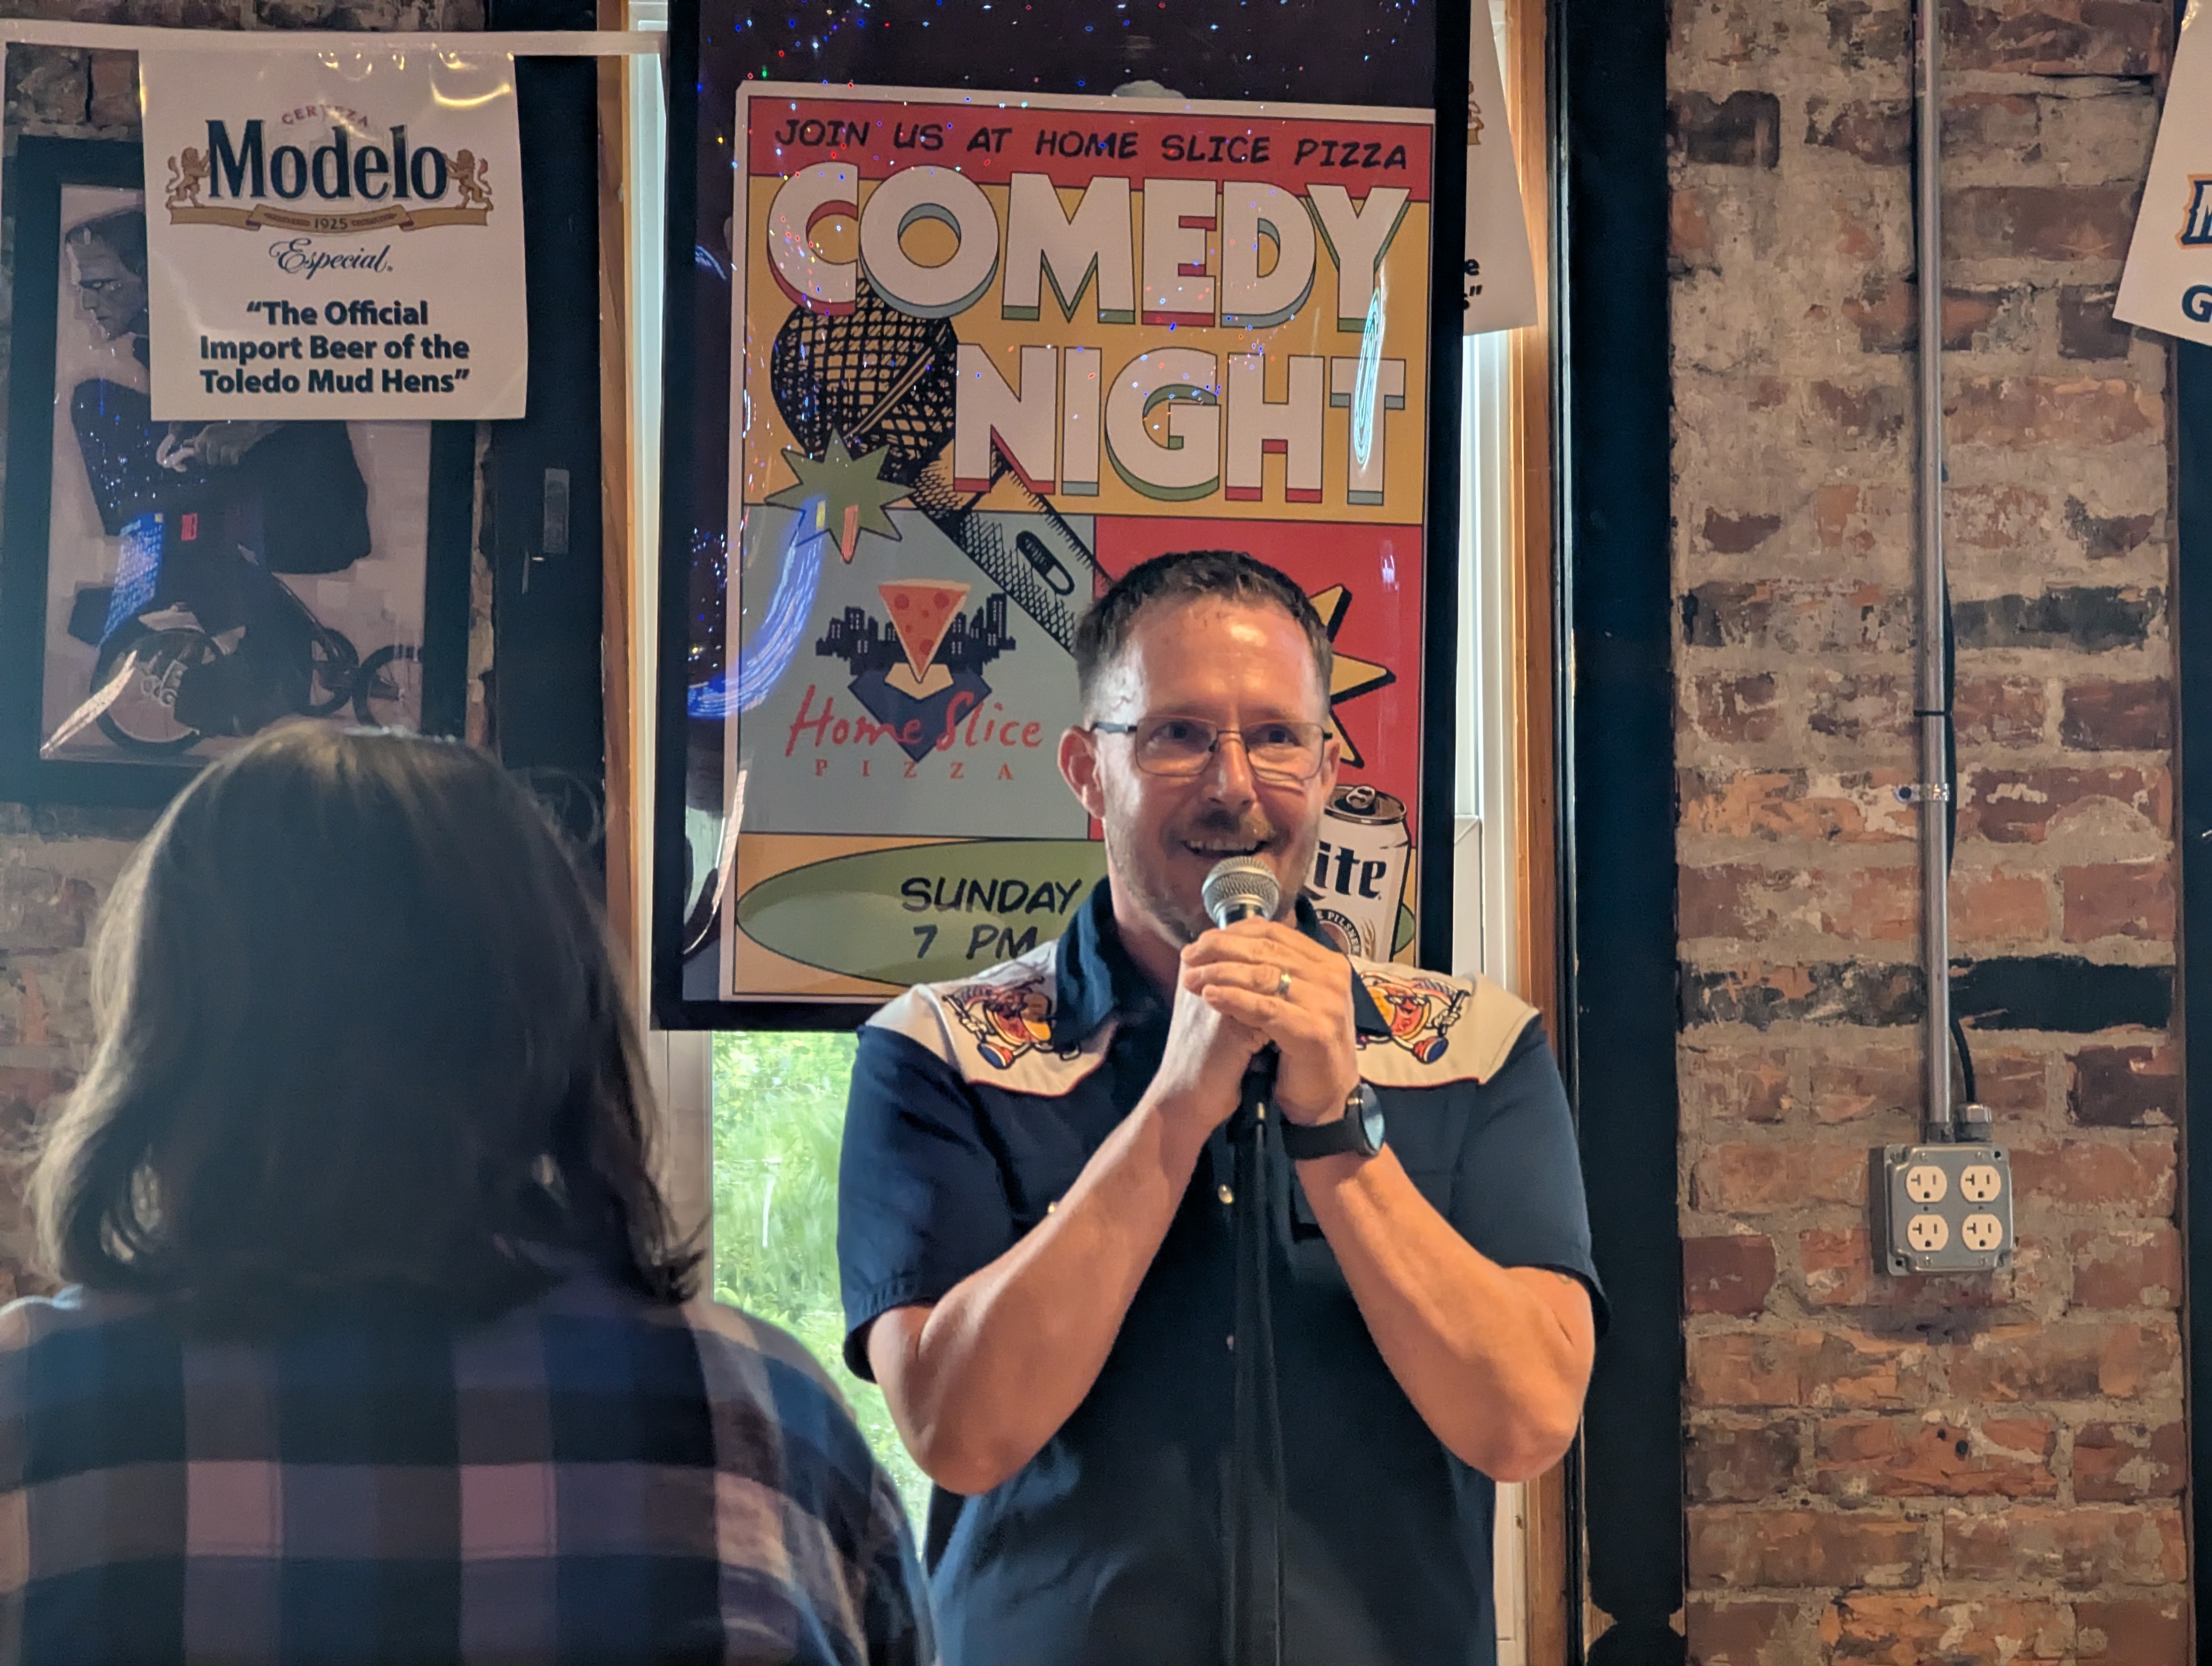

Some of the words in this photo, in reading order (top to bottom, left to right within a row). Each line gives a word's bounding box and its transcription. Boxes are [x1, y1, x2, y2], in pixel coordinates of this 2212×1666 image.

[205, 119, 449, 200] Modelo
[775, 119, 870, 147] JOIN
[893, 122, 944, 151] US
[967, 126, 1012, 153] AT
[1035, 129, 1139, 159] HOME
[1161, 134, 1270, 163] SLICE
[1294, 138, 1407, 170] PIZZA
[314, 218, 348, 230] 1925
[767, 161, 1411, 332] COMEDY
[246, 300, 318, 325] “The
[324, 300, 428, 325] Official
[200, 335, 303, 366] Import
[310, 335, 377, 359] Beer
[383, 333, 416, 359] of
[421, 334, 470, 359] the
[200, 367, 301, 394] Toledo
[307, 367, 375, 393] Mud
[381, 368, 470, 393] Hens”
[953, 343, 1406, 505] NIGHT
[785, 684, 923, 758] Home
[935, 691, 1044, 752] Slice
[901, 877, 1082, 915] SUNDAY
[913, 925, 938, 959] 7
[966, 924, 1038, 960] PM
